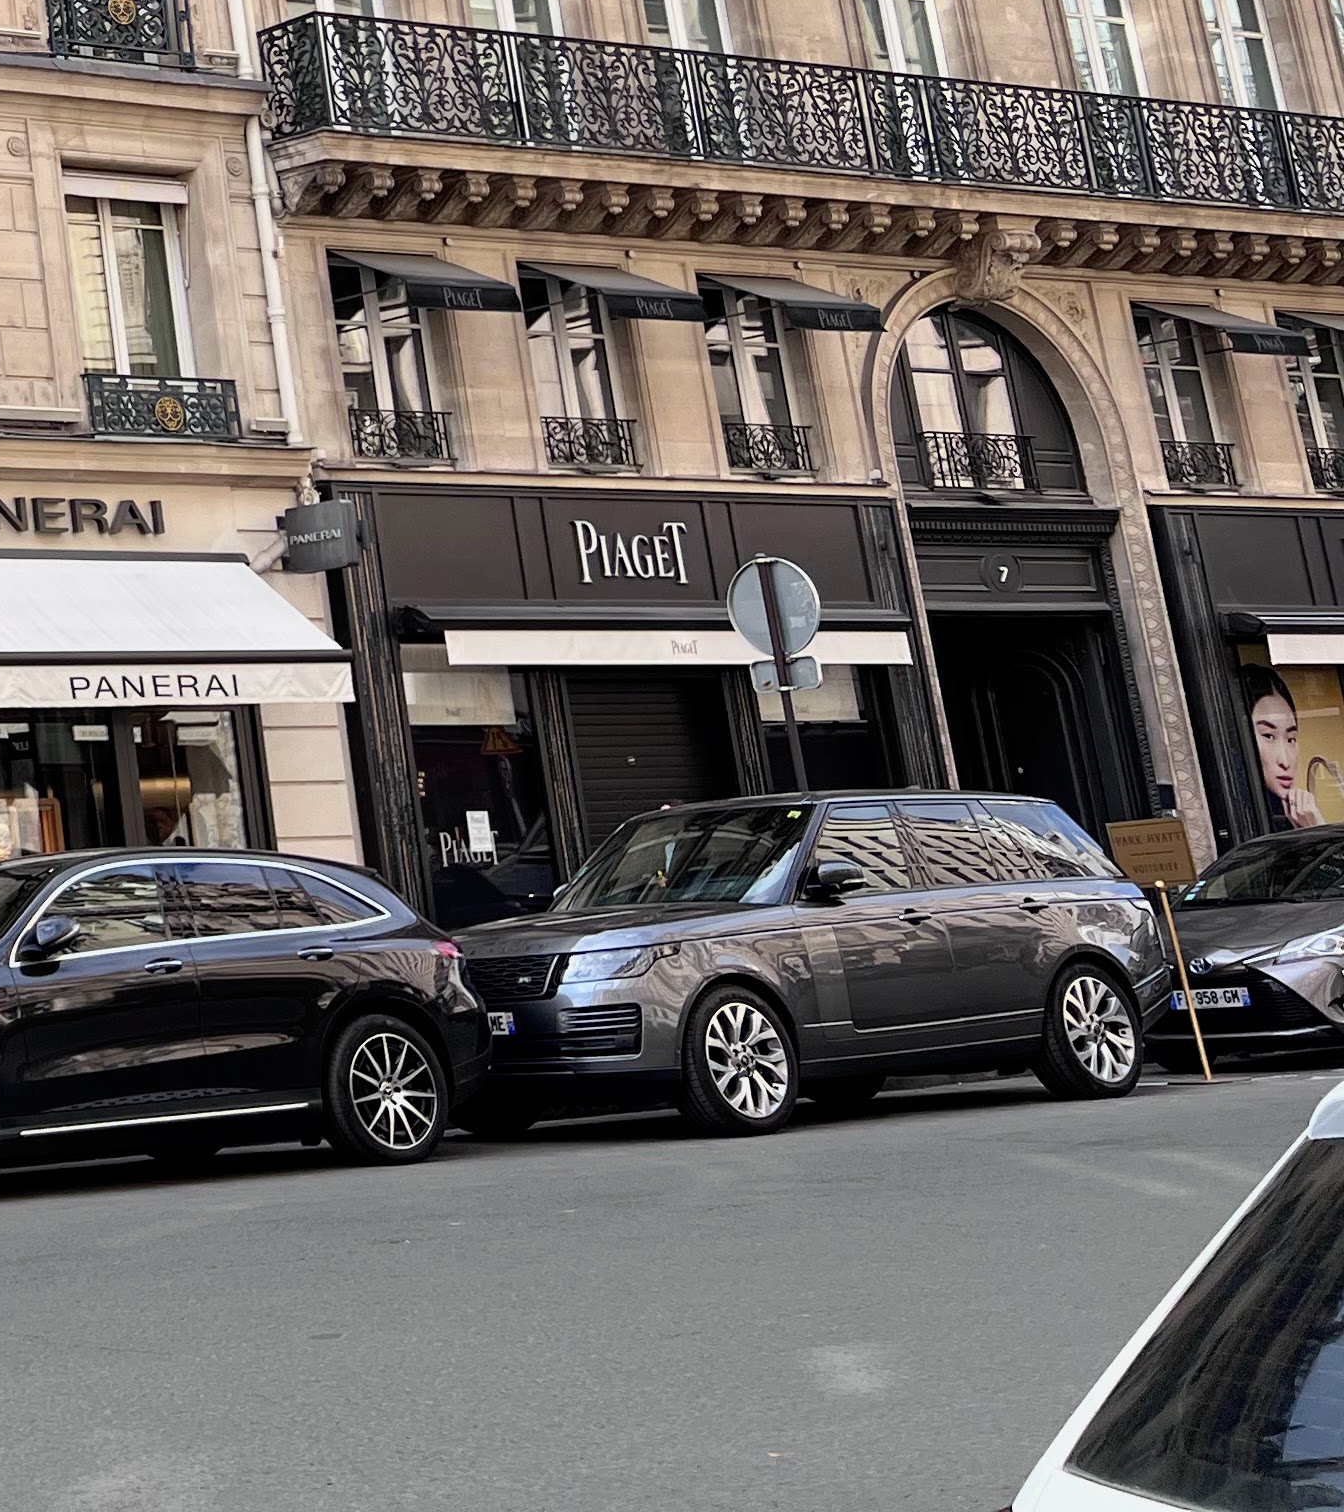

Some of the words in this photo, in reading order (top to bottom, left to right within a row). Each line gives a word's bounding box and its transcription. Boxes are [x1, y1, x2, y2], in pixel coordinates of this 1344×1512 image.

[443, 287, 483, 308] PIAGET
[636, 296, 673, 318] PIAGET
[817, 308, 853, 329] PIAGET
[290, 528, 342, 545] PANERAI
[573, 519, 688, 584] PIAGET
[998, 566, 1009, 583] 7
[69, 674, 240, 699] PANERAI
